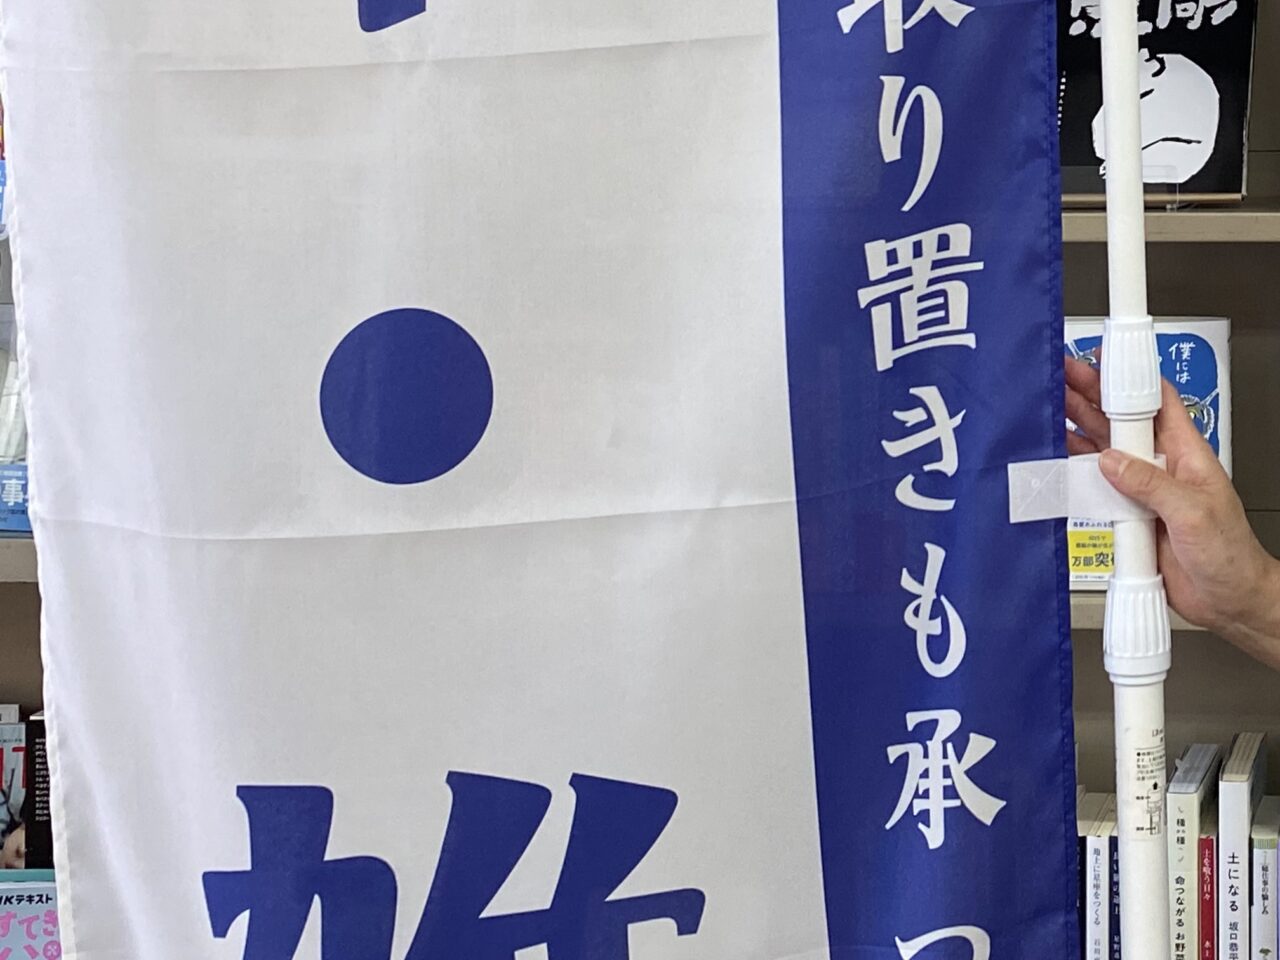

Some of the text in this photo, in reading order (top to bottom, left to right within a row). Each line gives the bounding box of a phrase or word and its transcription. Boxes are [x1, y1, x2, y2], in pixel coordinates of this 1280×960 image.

[1168, 342, 1197, 384] 僕には
[1071, 550, 1114, 569] 万部突
[1227, 851, 1240, 913] 土になる
[0, 894, 53, 906] Kテキスト
